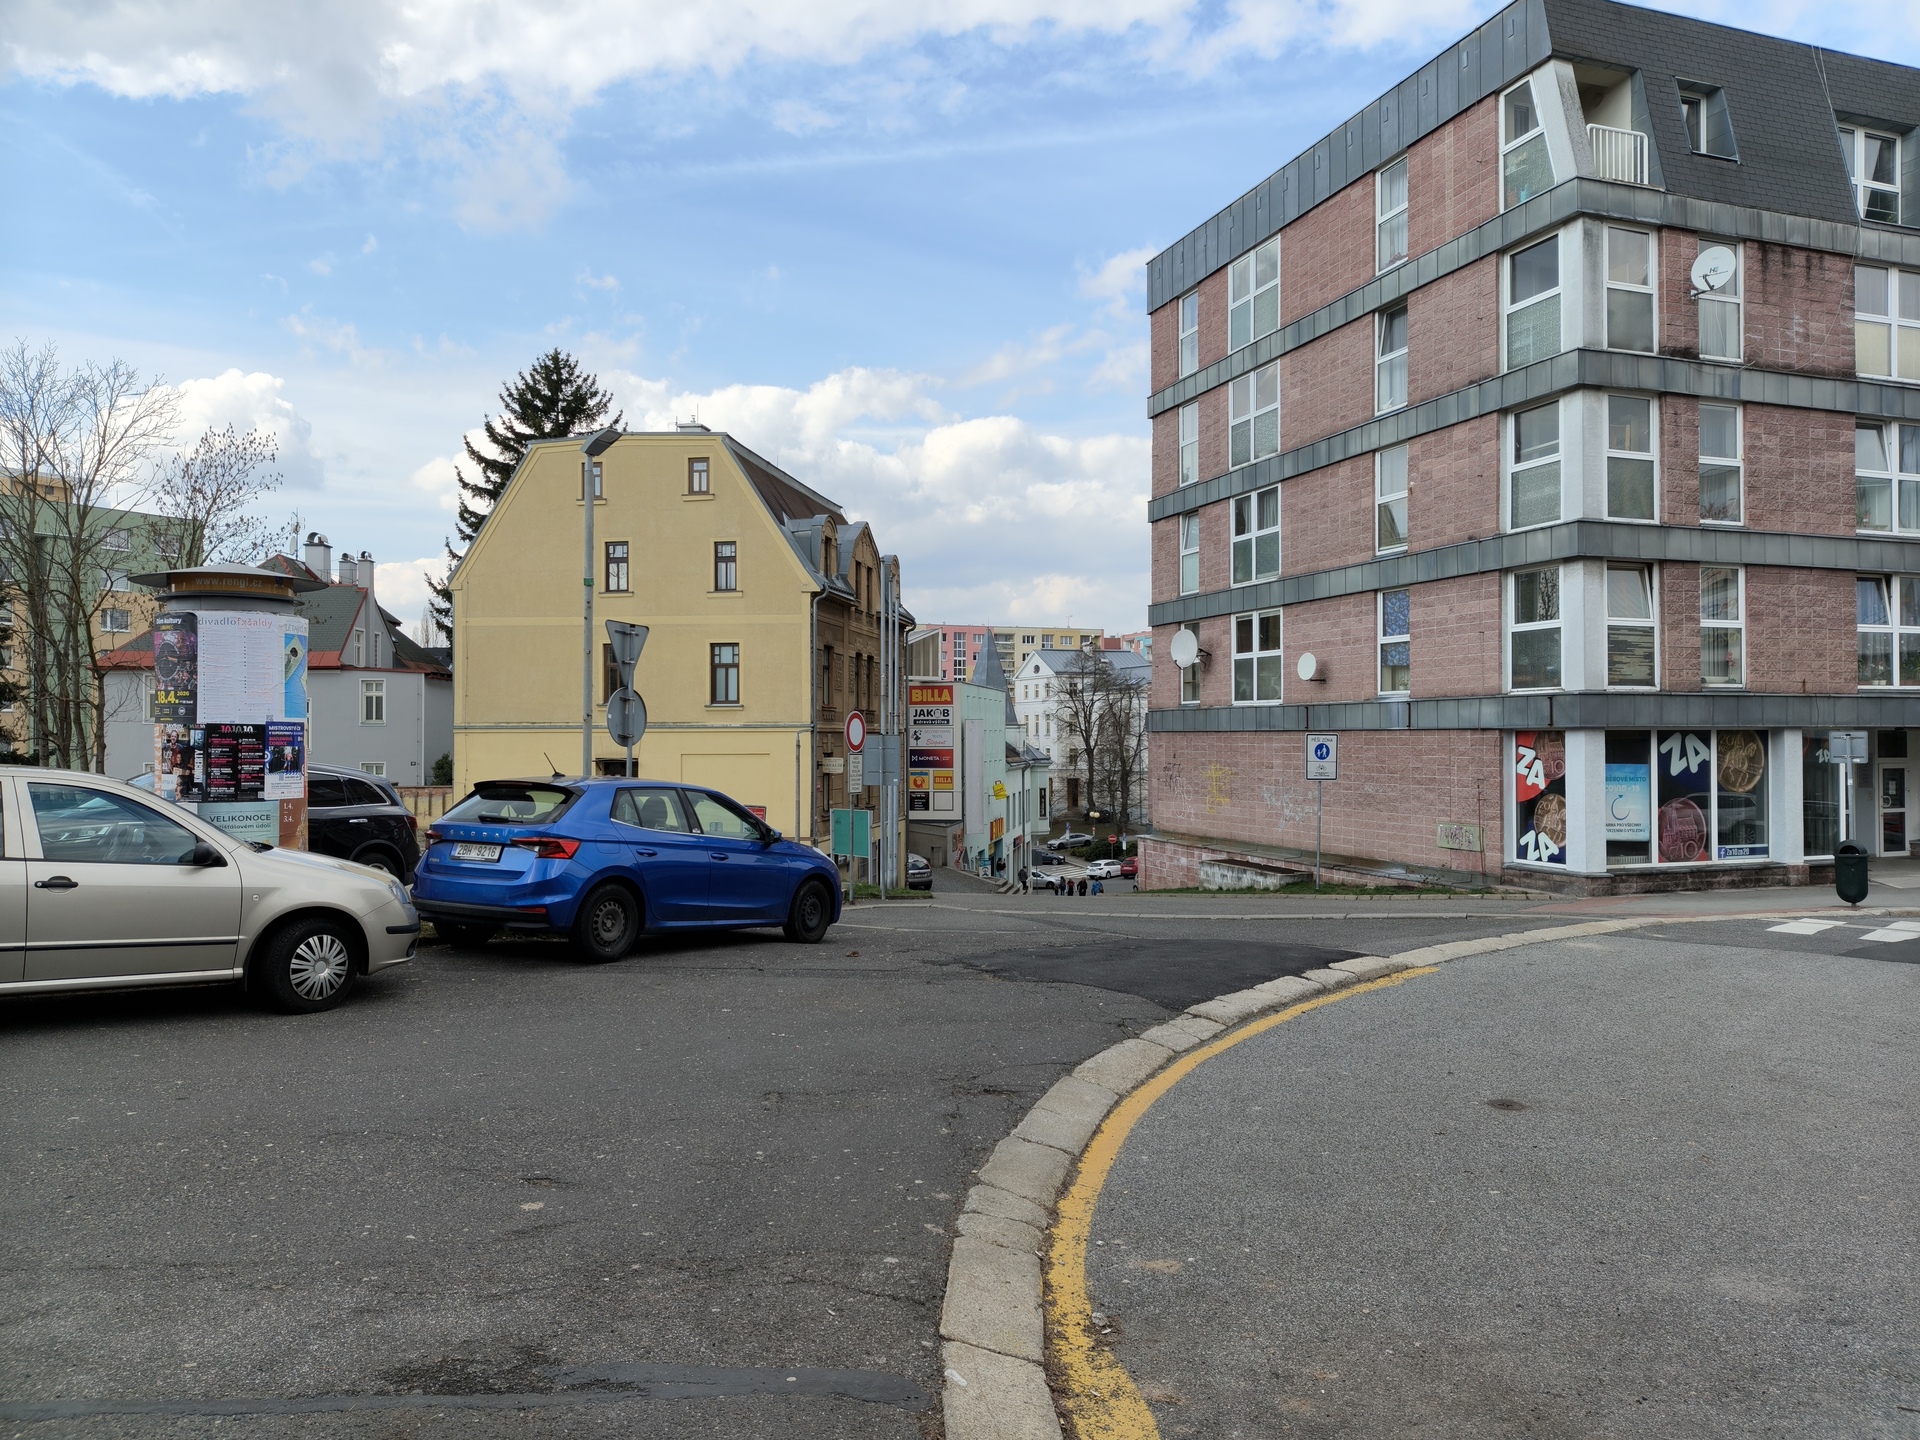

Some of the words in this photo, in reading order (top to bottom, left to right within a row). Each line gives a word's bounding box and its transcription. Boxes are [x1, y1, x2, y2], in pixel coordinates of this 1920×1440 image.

[157, 690, 179, 704] 18.4.
[912, 689, 951, 702] BILLA
[913, 708, 950, 718] JAKOB
[1660, 732, 1710, 776] ZA
[1516, 745, 1546, 790] ZA
[209, 814, 271, 822] VELIKONOCE
[450, 830, 500, 838] ŠKODA
[457, 844, 473, 856] 2BH
[476, 846, 497, 858] 9216
